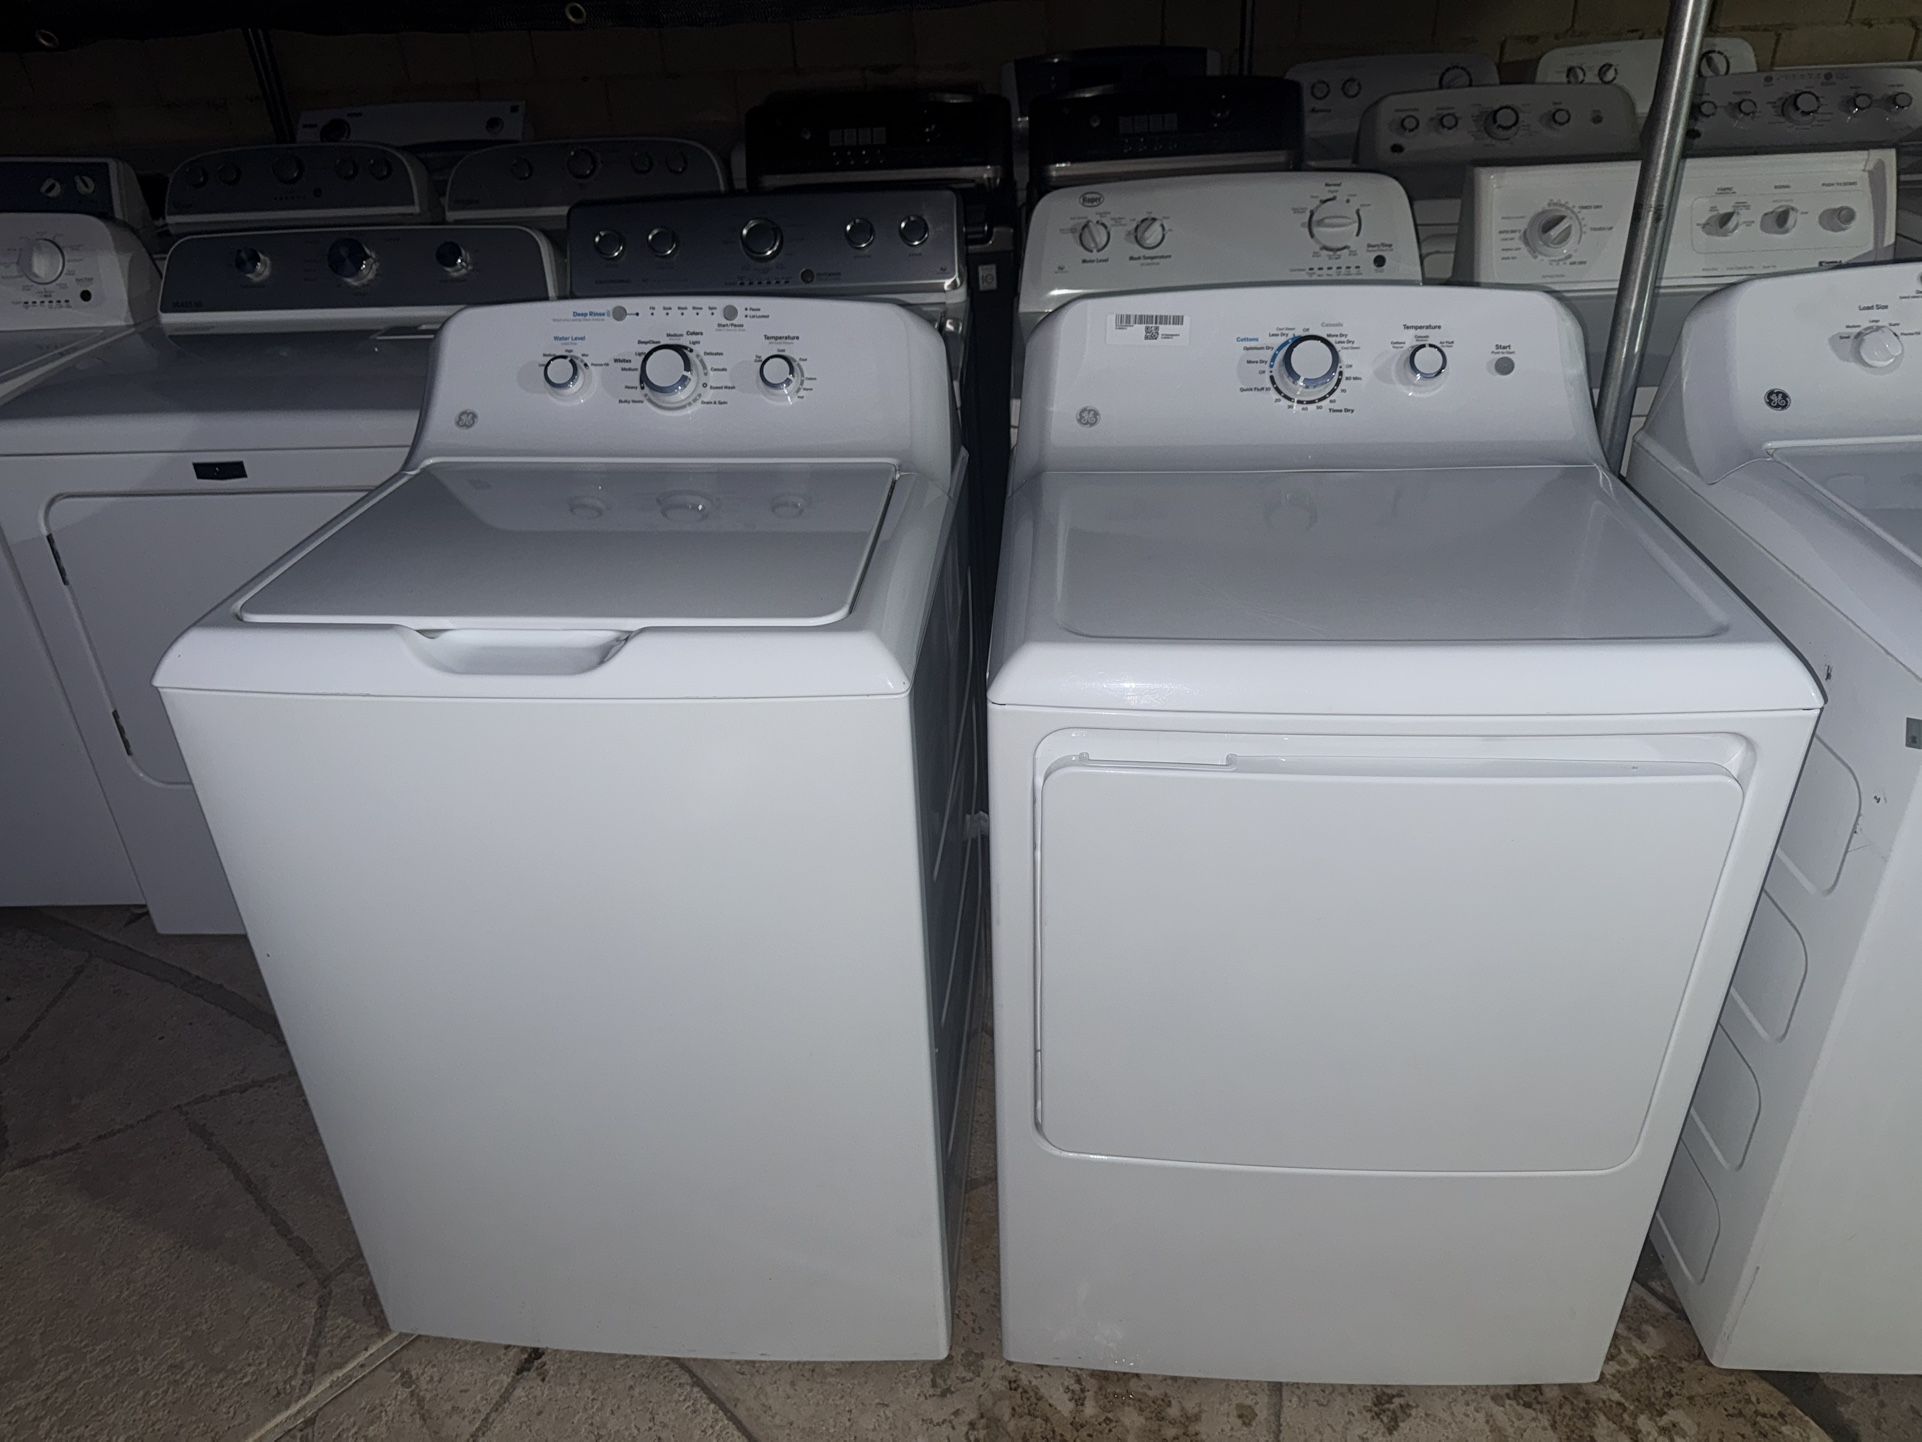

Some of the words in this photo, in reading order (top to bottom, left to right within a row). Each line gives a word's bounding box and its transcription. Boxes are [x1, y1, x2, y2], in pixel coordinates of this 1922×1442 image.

[763, 334, 800, 342] Temperature
[1764, 388, 1792, 411] GE
[1076, 406, 1101, 428] GE
